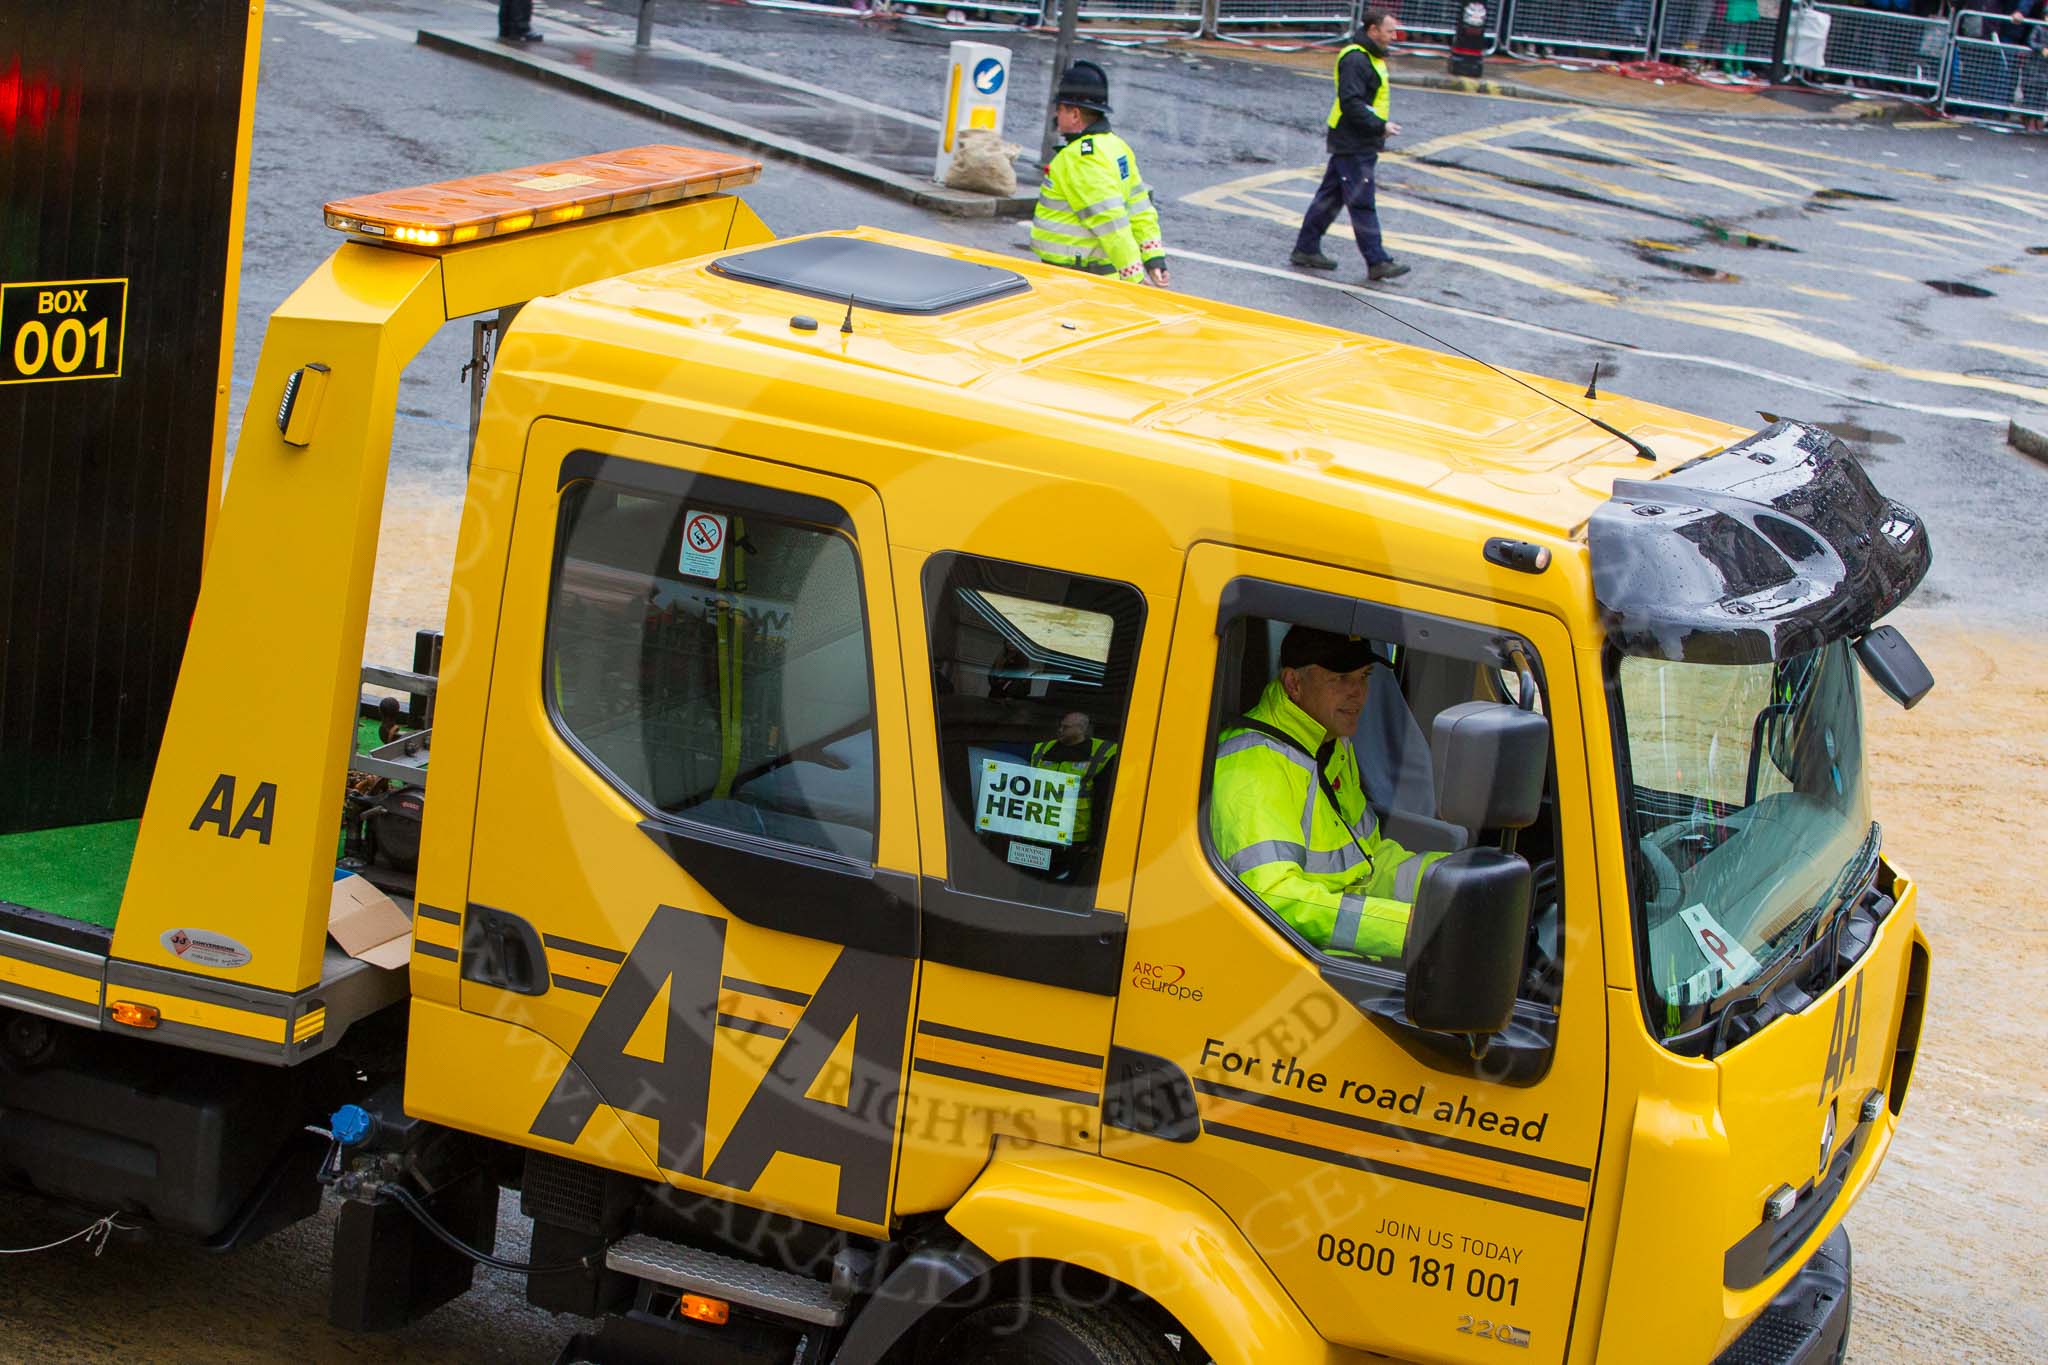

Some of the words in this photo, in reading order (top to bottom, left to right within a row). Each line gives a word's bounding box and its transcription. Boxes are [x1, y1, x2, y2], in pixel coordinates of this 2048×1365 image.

[38, 290, 88, 314] BOX
[14, 317, 108, 375] 001
[189, 773, 278, 845] AA
[986, 794, 1062, 827] HERE
[989, 773, 1065, 803] JOIN
[1133, 961, 1163, 978] ARC
[1140, 977, 1203, 1001] europe
[1817, 968, 1863, 1107] AA
[529, 903, 910, 1226] AA
[1199, 1037, 1260, 1074] For
[1271, 1057, 1327, 1094] the
[1339, 1079, 1425, 1116] road
[1433, 1096, 1549, 1143] ahead
[1375, 1218, 1421, 1243] JOIN
[1428, 1230, 1454, 1250] US
[1461, 1236, 1524, 1265] TODAY
[1317, 1233, 1395, 1276] 0800
[1409, 1255, 1455, 1291] 181
[1466, 1268, 1520, 1307] 001
[1456, 1314, 1515, 1342] 220
